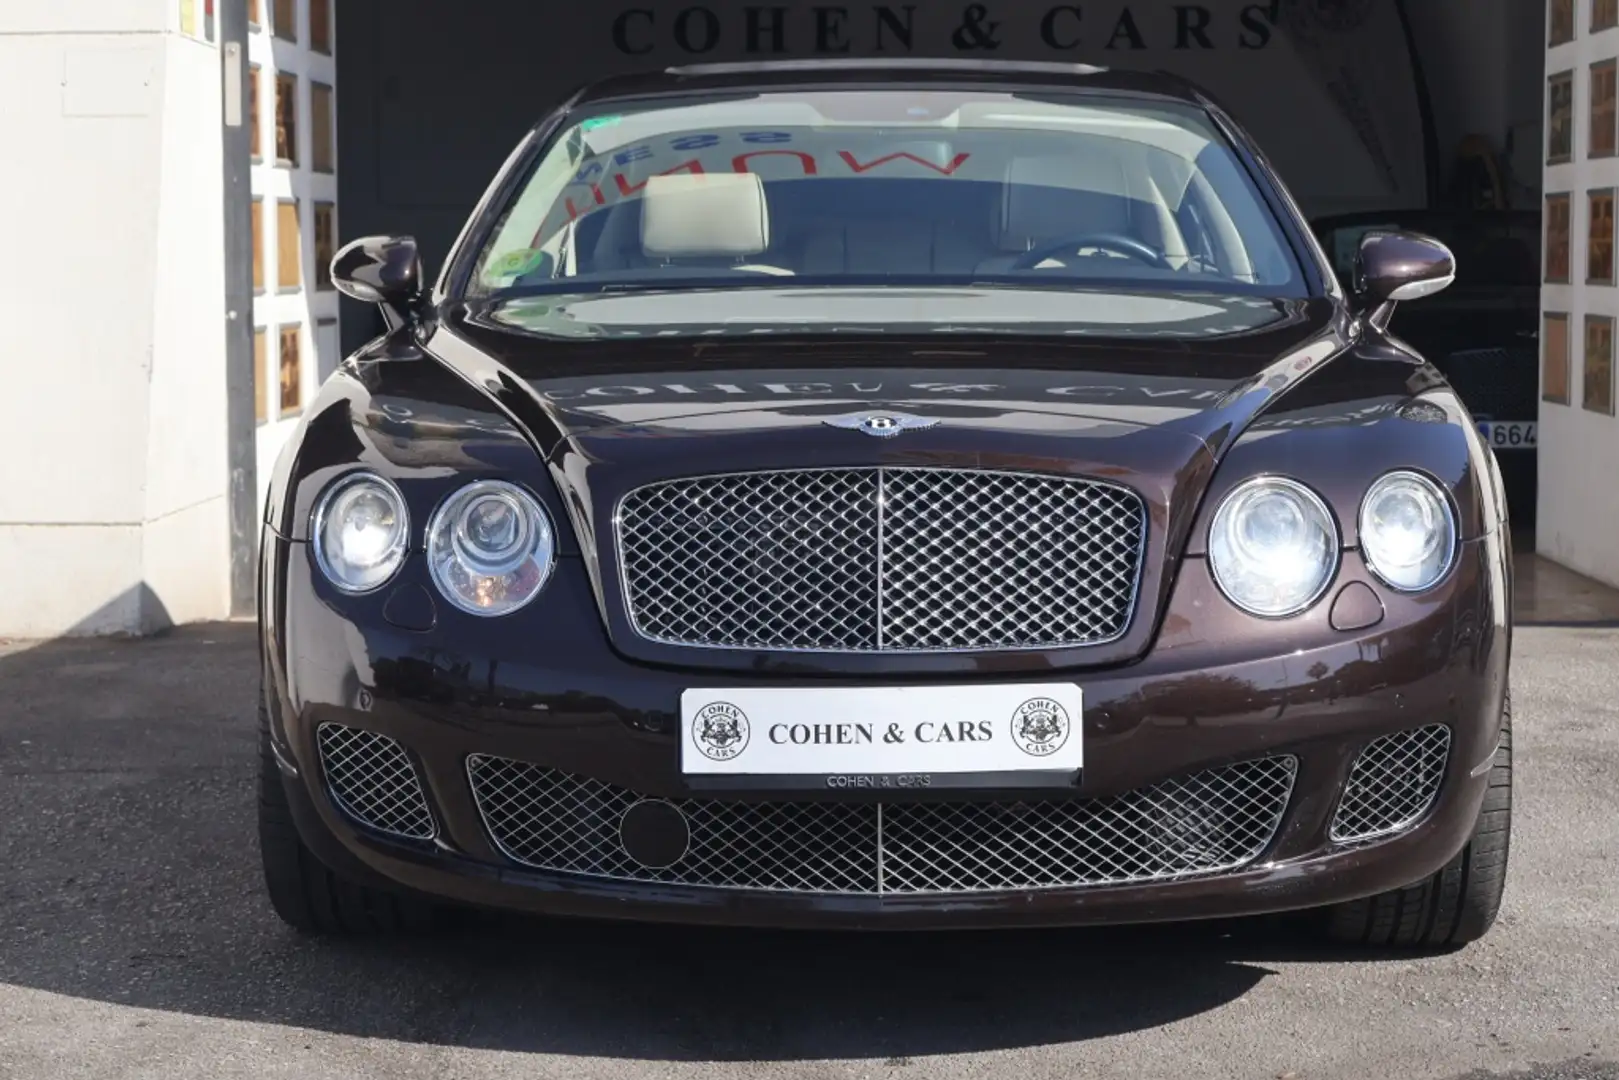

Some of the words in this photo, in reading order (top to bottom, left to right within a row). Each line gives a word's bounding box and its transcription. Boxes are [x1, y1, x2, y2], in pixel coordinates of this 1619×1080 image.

[611, 4, 917, 56] COHEN
[950, 4, 1003, 50] &
[1040, 4, 1272, 50] CARS
[768, 722, 874, 745] COHEN
[882, 722, 905, 744] &
[914, 720, 993, 743] CARS
[826, 775, 875, 788] COHEN
[897, 774, 931, 787] CARS
